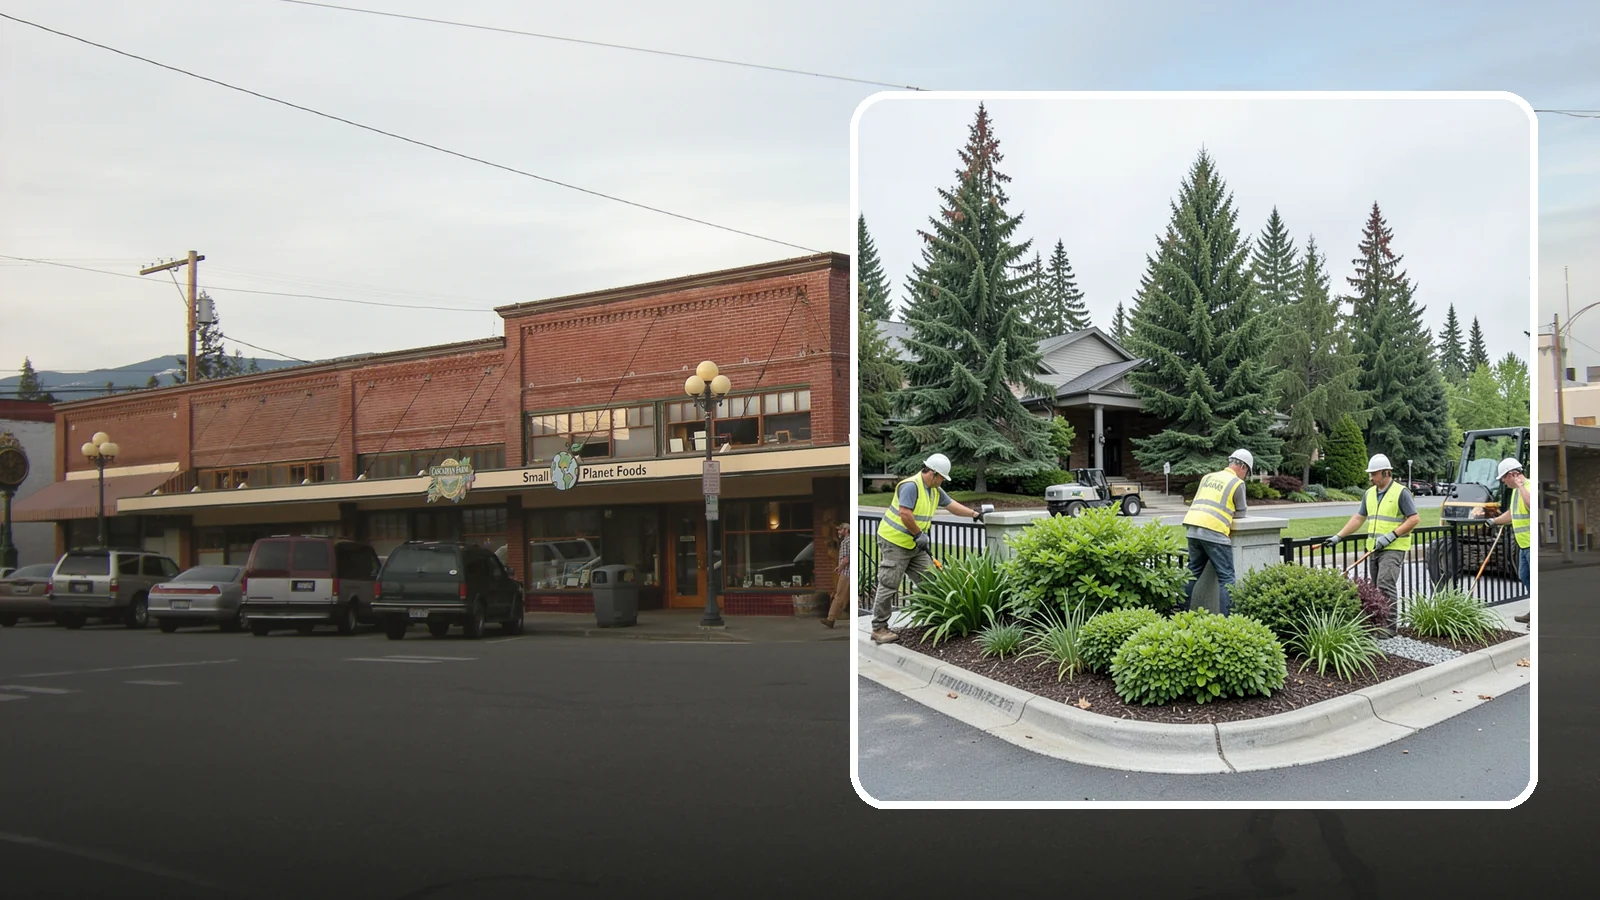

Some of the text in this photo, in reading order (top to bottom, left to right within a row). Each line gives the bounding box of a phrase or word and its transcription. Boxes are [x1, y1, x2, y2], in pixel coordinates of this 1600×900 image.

[522, 464, 647, 483] Small Planet Foods
